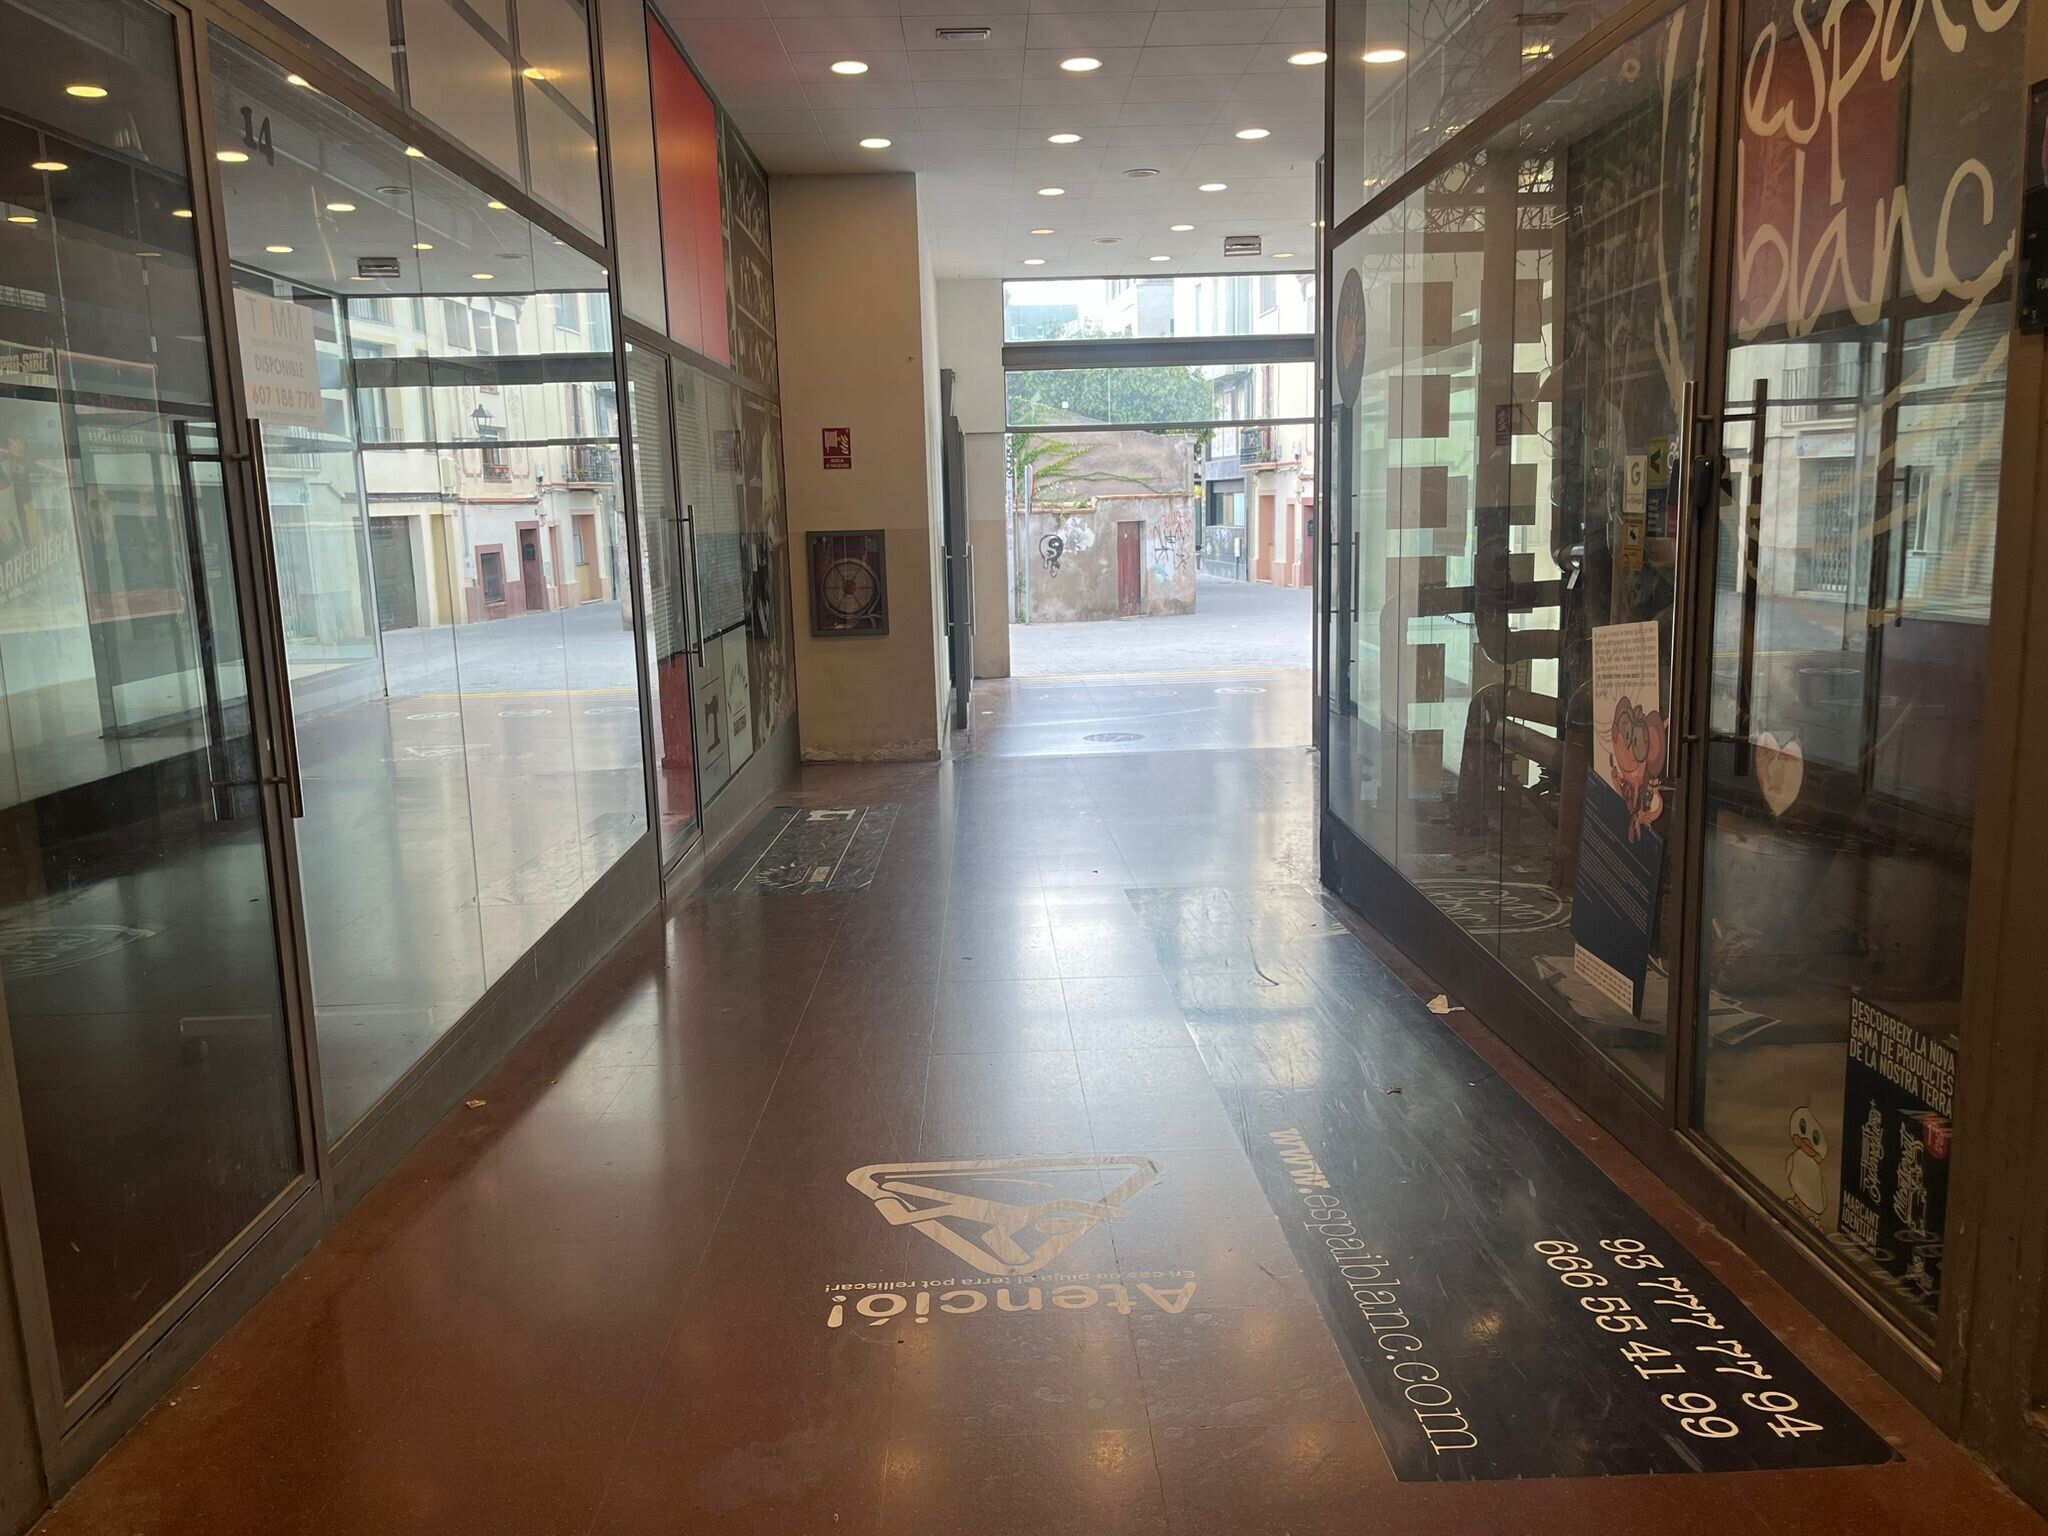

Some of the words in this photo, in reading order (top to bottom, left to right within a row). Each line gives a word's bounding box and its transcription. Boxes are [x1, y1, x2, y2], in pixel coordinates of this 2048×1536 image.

[240, 106, 275, 167] 14
[1738, 139, 2016, 341] blanc
[254, 353, 305, 378] DISPONIBLE
[252, 384, 272, 405] 607
[275, 387, 295, 409] 188
[296, 389, 315, 410] 770
[1851, 1018, 1879, 1052] GAMA
[1881, 1034, 1895, 1060] DE
[1896, 1043, 1954, 1097] PRODUCTES
[1852, 997, 1913, 1050] DESCOBREIX
[1914, 1031, 1927, 1058] LA
[1929, 1040, 1955, 1076] NOVA
[1849, 1038, 1863, 1062] DE
[1864, 1046, 1877, 1071] LA
[1879, 1055, 1919, 1097] NOSTRA
[1921, 1079, 1953, 1121] TERRA
[1841, 1206, 1879, 1247] IDENTITAT
[1843, 1189, 1880, 1225] MARCANT
[824, 1281, 916, 1293] relliscar!
[919, 1278, 956, 1289] pot
[1170, 1270, 1196, 1279] En
[1269, 1127, 1478, 1456] www.espaiblanc.com
[826, 1281, 1198, 1328] Atenció!
[1533, 1240, 1609, 1289] 666
[1580, 1296, 1649, 1333] 55
[1619, 1340, 1687, 1381] 41
[1660, 1392, 1740, 1439] 99
[1599, 1238, 1665, 1270] 93
[1637, 1276, 1725, 1331] 777
[1695, 1339, 1773, 1380] 77
[1741, 1391, 1825, 1439] 94
